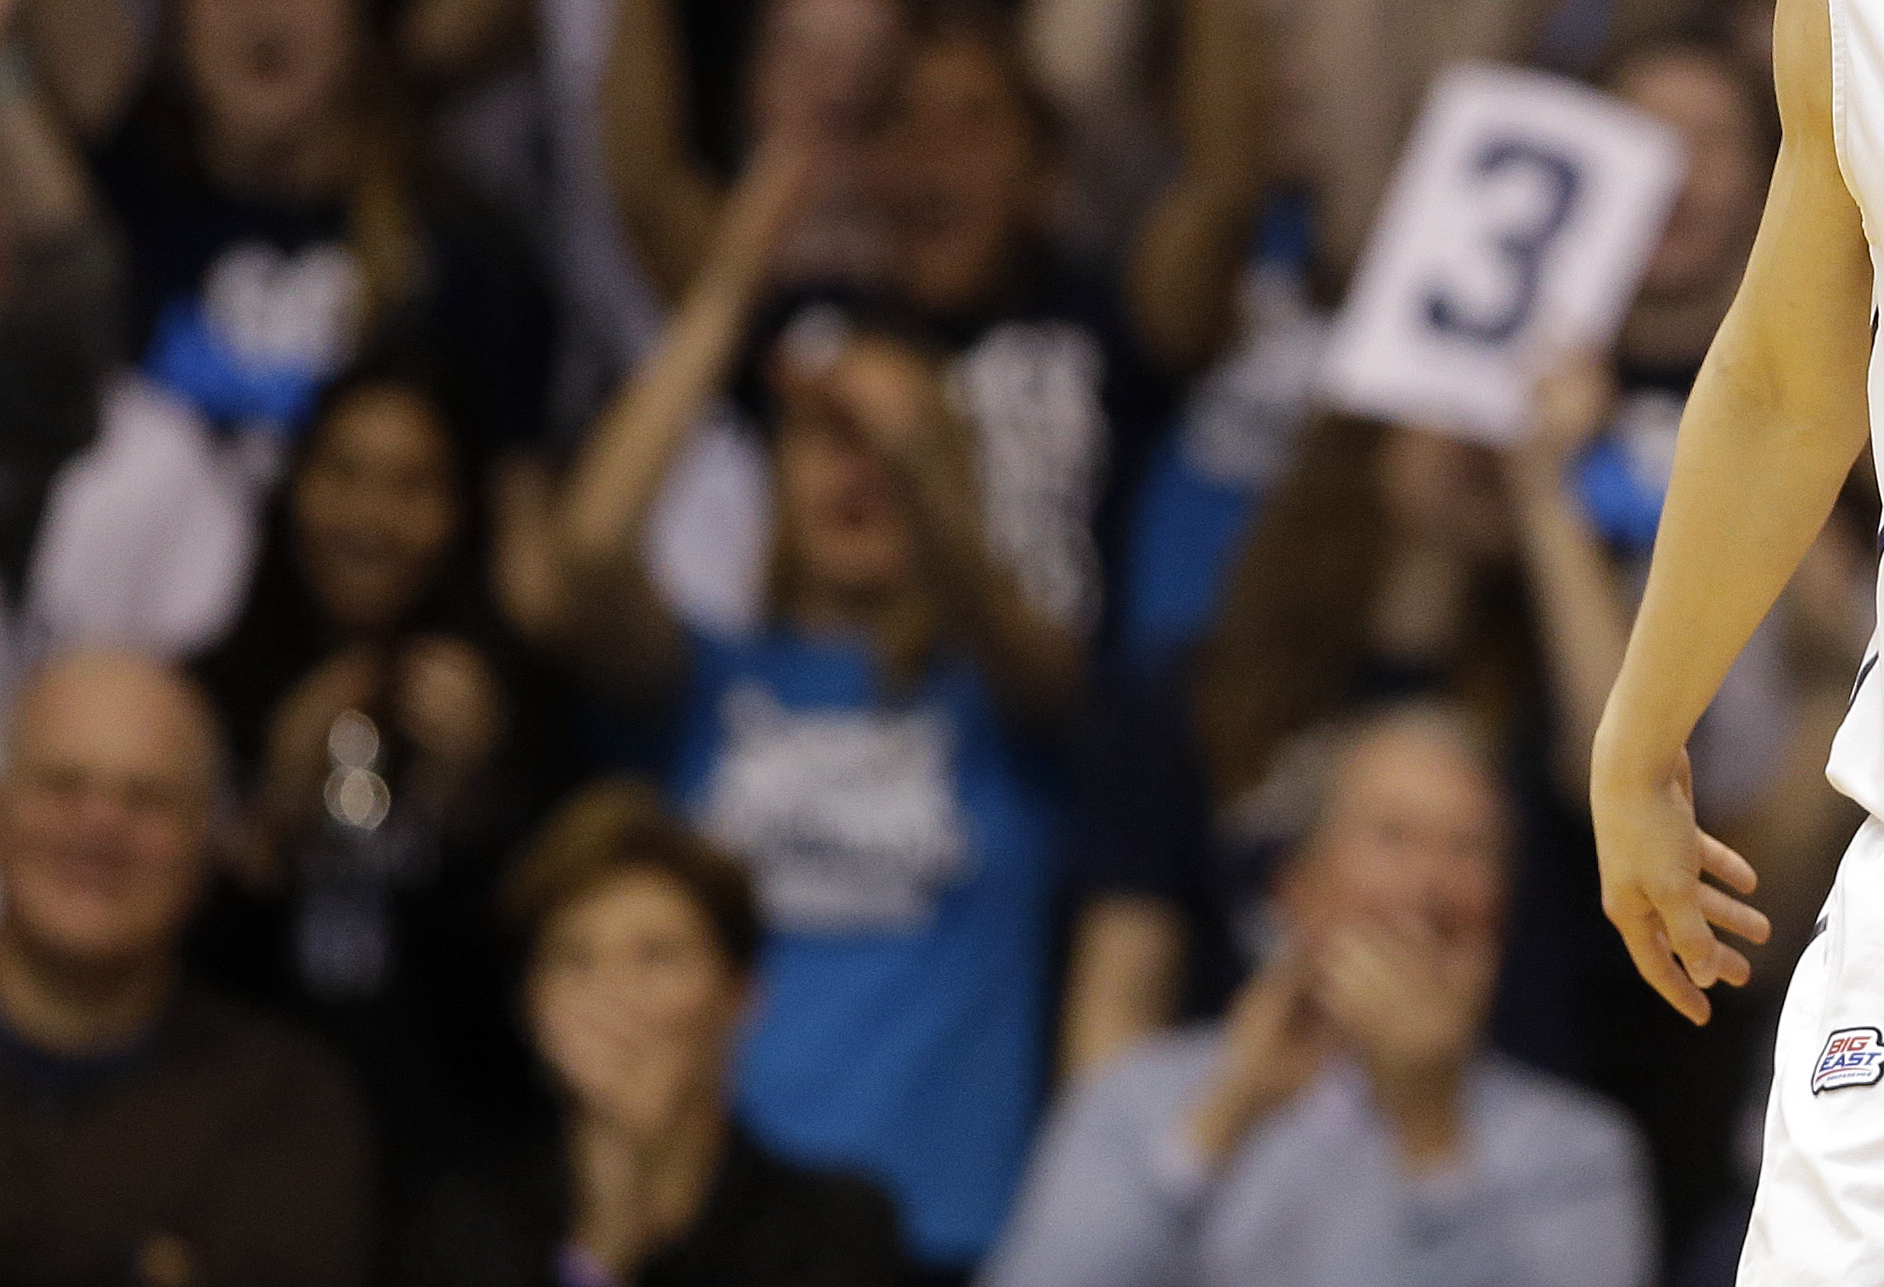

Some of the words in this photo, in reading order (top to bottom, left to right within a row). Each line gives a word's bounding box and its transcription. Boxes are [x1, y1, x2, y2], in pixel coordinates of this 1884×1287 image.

[1422, 136, 1588, 348] 3
[1828, 1036, 1871, 1054] BIG
[1819, 1052, 1882, 1072] EAST
